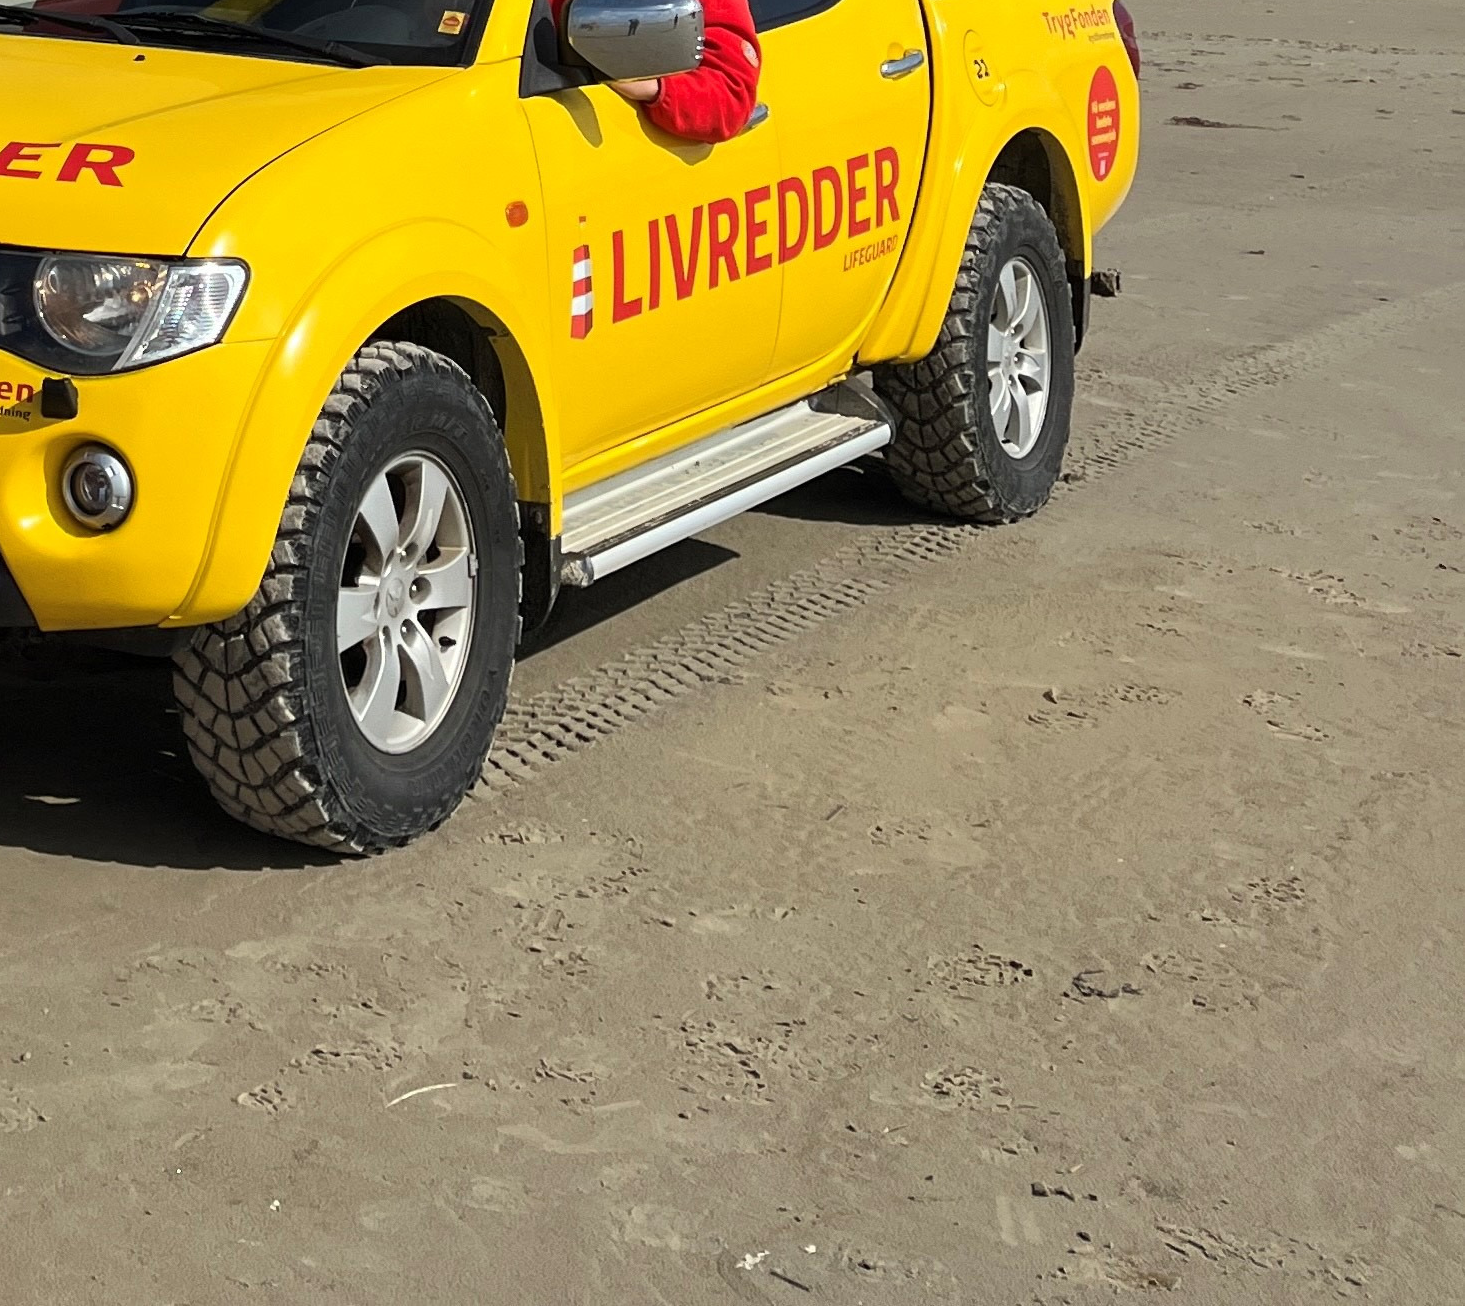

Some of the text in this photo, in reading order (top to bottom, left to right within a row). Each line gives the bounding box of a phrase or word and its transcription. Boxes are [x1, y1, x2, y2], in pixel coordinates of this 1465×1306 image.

[1041, 4, 1112, 41] TrygFonden
[611, 145, 901, 325] LIVREDDER
[842, 234, 899, 272] LIFEGUARD
